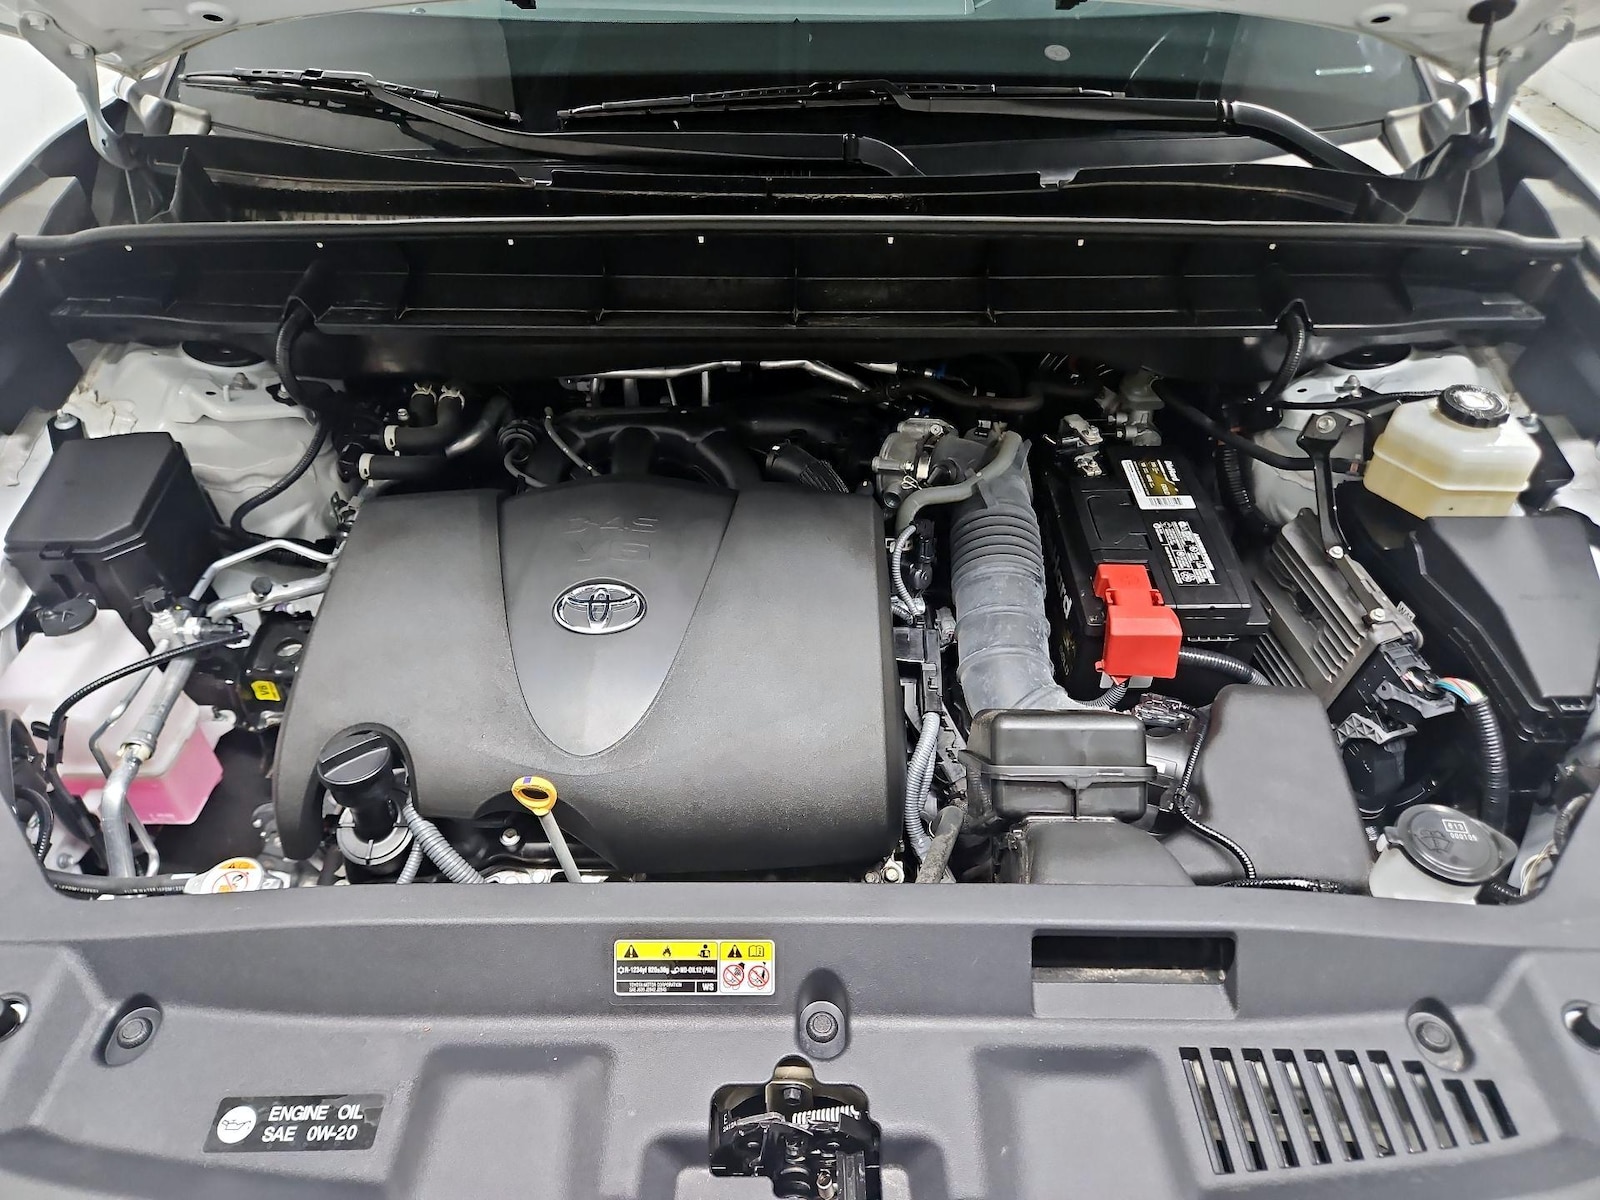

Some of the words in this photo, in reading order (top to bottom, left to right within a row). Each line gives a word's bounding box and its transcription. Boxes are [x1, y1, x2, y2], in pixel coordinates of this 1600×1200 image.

[268, 1105, 330, 1122] ENGINE
[337, 1104, 364, 1120] OIL
[261, 1126, 298, 1143] SAE
[306, 1125, 358, 1141] 0W-20
